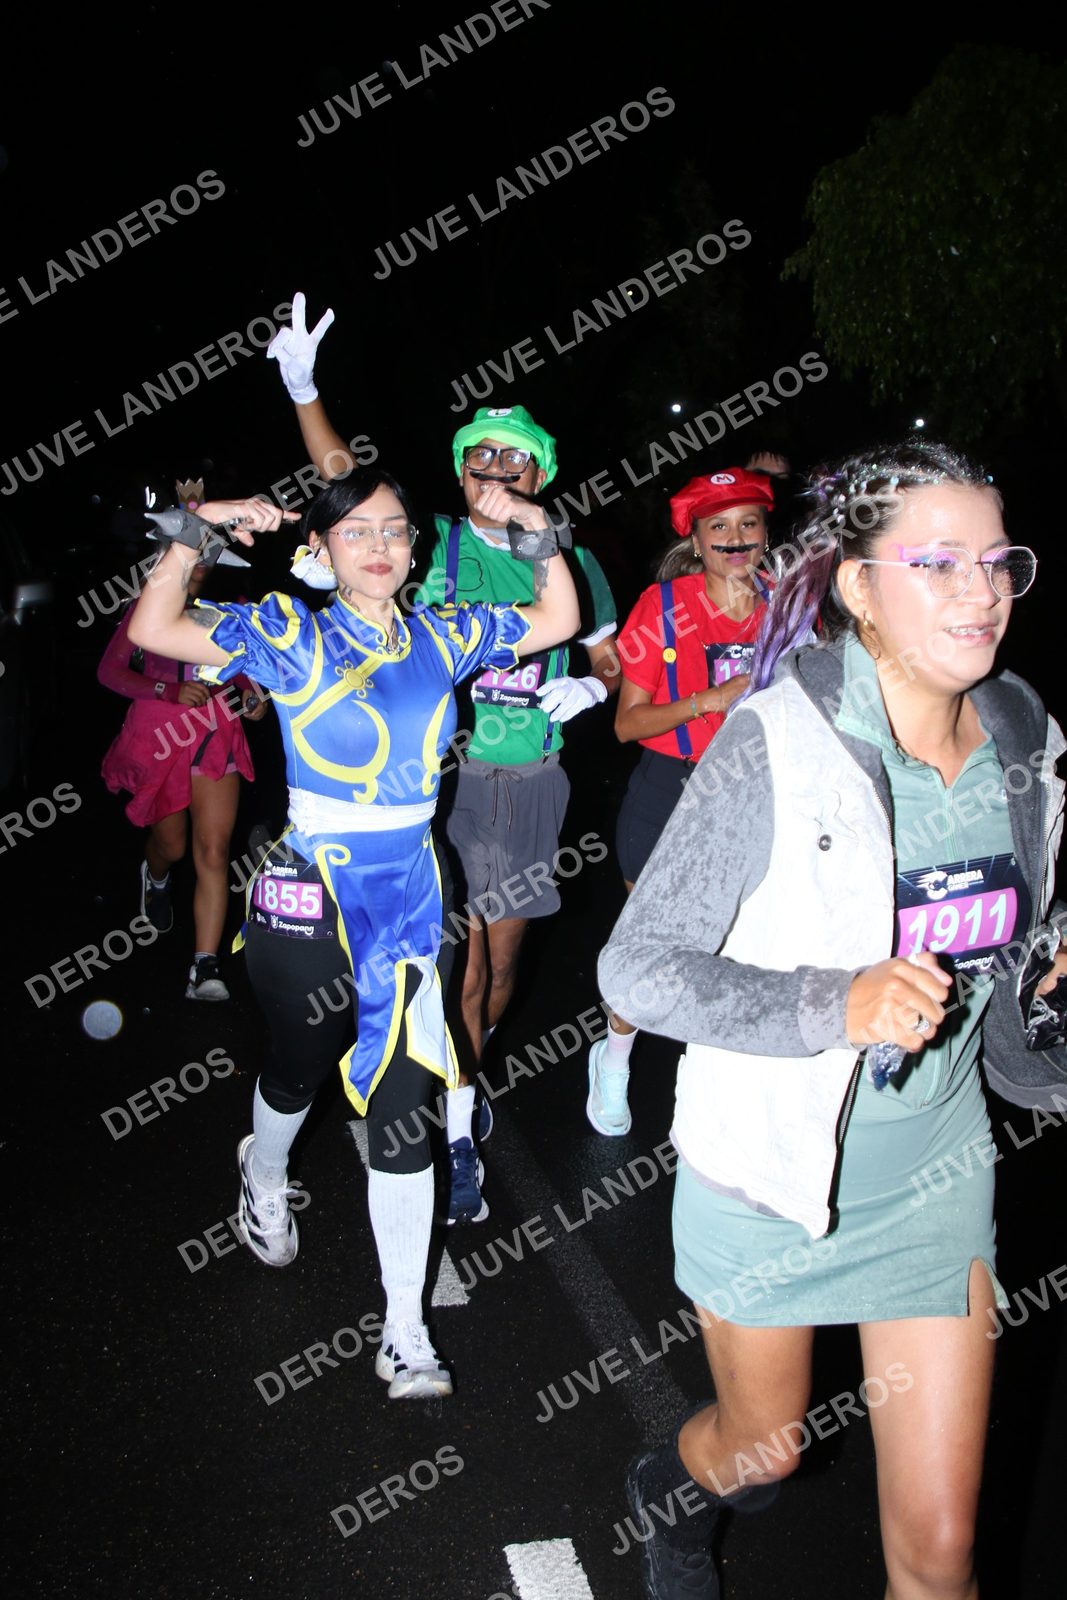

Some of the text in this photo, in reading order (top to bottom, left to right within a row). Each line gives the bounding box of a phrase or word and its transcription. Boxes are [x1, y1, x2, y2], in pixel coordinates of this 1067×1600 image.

[476, 664, 538, 690] 126
[256, 875, 321, 916] 1855
[908, 893, 1007, 956] 1911
